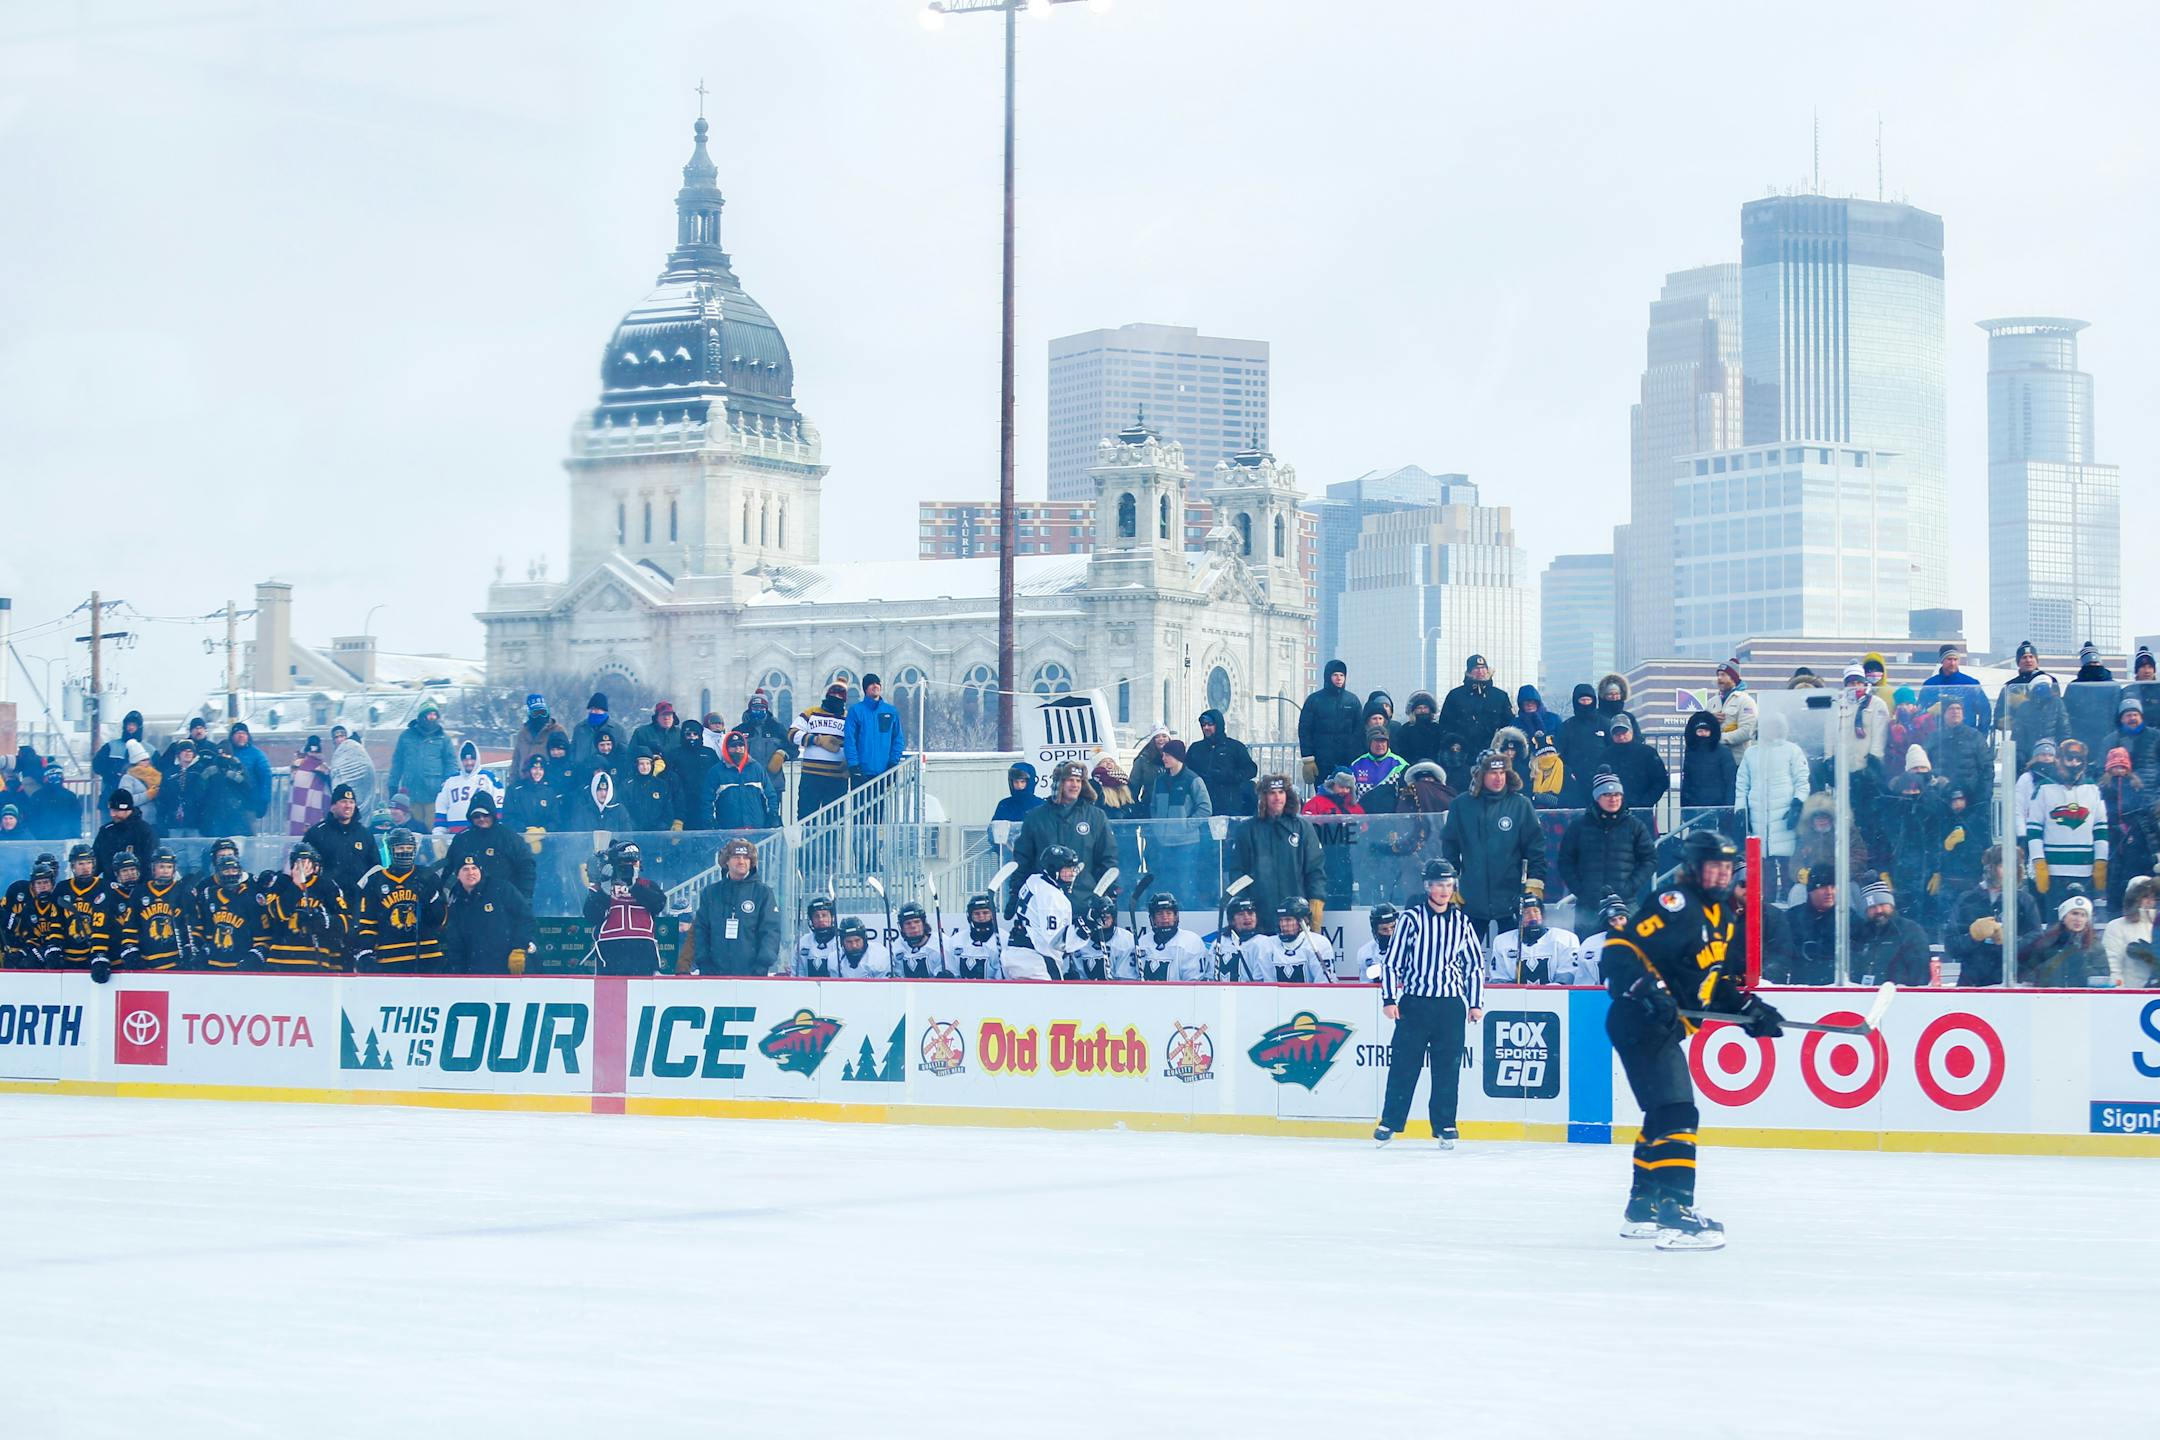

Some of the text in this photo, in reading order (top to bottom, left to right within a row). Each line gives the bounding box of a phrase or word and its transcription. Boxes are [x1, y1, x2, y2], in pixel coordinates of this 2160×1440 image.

[962, 510, 970, 559] LAURE
[809, 719, 845, 732] MINNESO
[451, 786, 480, 803] US
[1636, 914, 1665, 938] 5
[182, 1013, 314, 1048] TOYOTA
[380, 1006, 440, 1034] THIS
[440, 1002, 756, 1079] OUR ICE
[979, 1022, 1147, 1074] Old Dutch
[1495, 1021, 1547, 1048] FOX
[407, 1039, 434, 1066] IS
[1495, 1048, 1548, 1060] SPORTS
[1496, 1060, 1546, 1087] GO
